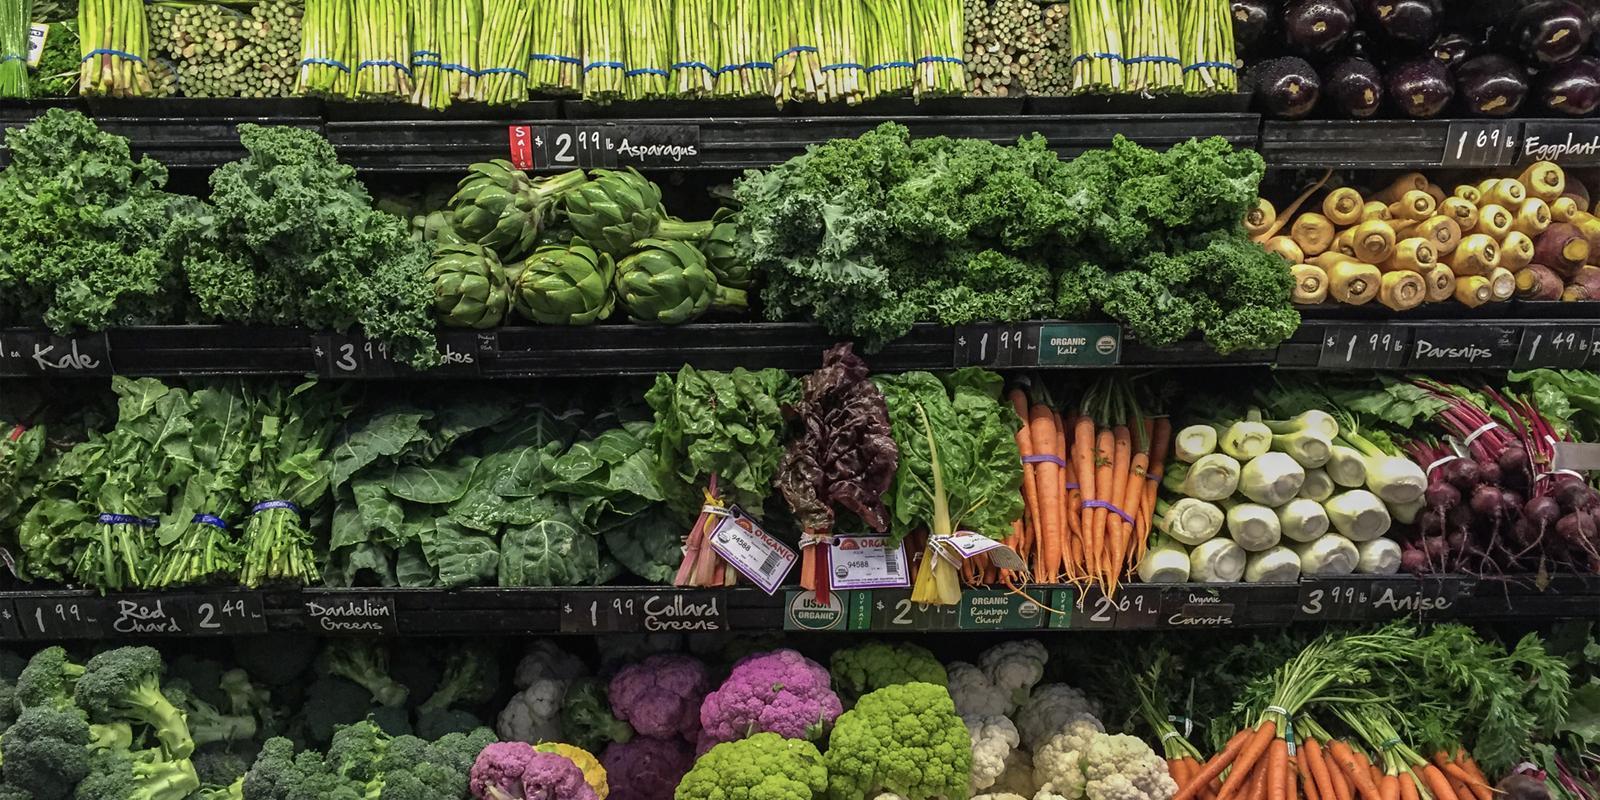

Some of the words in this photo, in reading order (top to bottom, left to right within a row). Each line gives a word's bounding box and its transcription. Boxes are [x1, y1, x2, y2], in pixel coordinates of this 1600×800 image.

[534, 135, 543, 147] $
[605, 138, 614, 150] lb
[1506, 136, 1514, 148] lb
[1525, 132, 1600, 161] Eggplant
[616, 138, 698, 161] Asparagus
[958, 336, 967, 347] $
[1050, 338, 1086, 346] ORGANIC
[1327, 336, 1335, 348] $
[1394, 340, 1403, 351] lb
[32, 339, 100, 370] Kale
[315, 345, 324, 357] $
[440, 344, 474, 364] okes
[1057, 346, 1078, 355] Kale
[1416, 340, 1492, 363] Parsnips
[731, 534, 752, 552] 94588
[754, 528, 794, 562] ORGANIC
[861, 539, 888, 549] ORGA
[842, 561, 869, 569] 94588
[803, 598, 831, 608] US
[972, 596, 1009, 605] ORGANIC
[1188, 593, 1221, 604] Organic
[1373, 588, 1452, 611] Anise
[117, 600, 166, 619] Red
[305, 599, 390, 616] Dandelion
[564, 603, 573, 614] $
[644, 595, 720, 616] Collard
[876, 600, 885, 610] $
[2, 609, 12, 619] $
[798, 611, 834, 620] ORGANIC
[970, 607, 1009, 616] Rainbow
[113, 617, 182, 632] Chard
[320, 616, 383, 630] Greens
[645, 616, 720, 631] Greens
[975, 616, 1003, 624] Chard
[1168, 614, 1233, 625] Carrots
